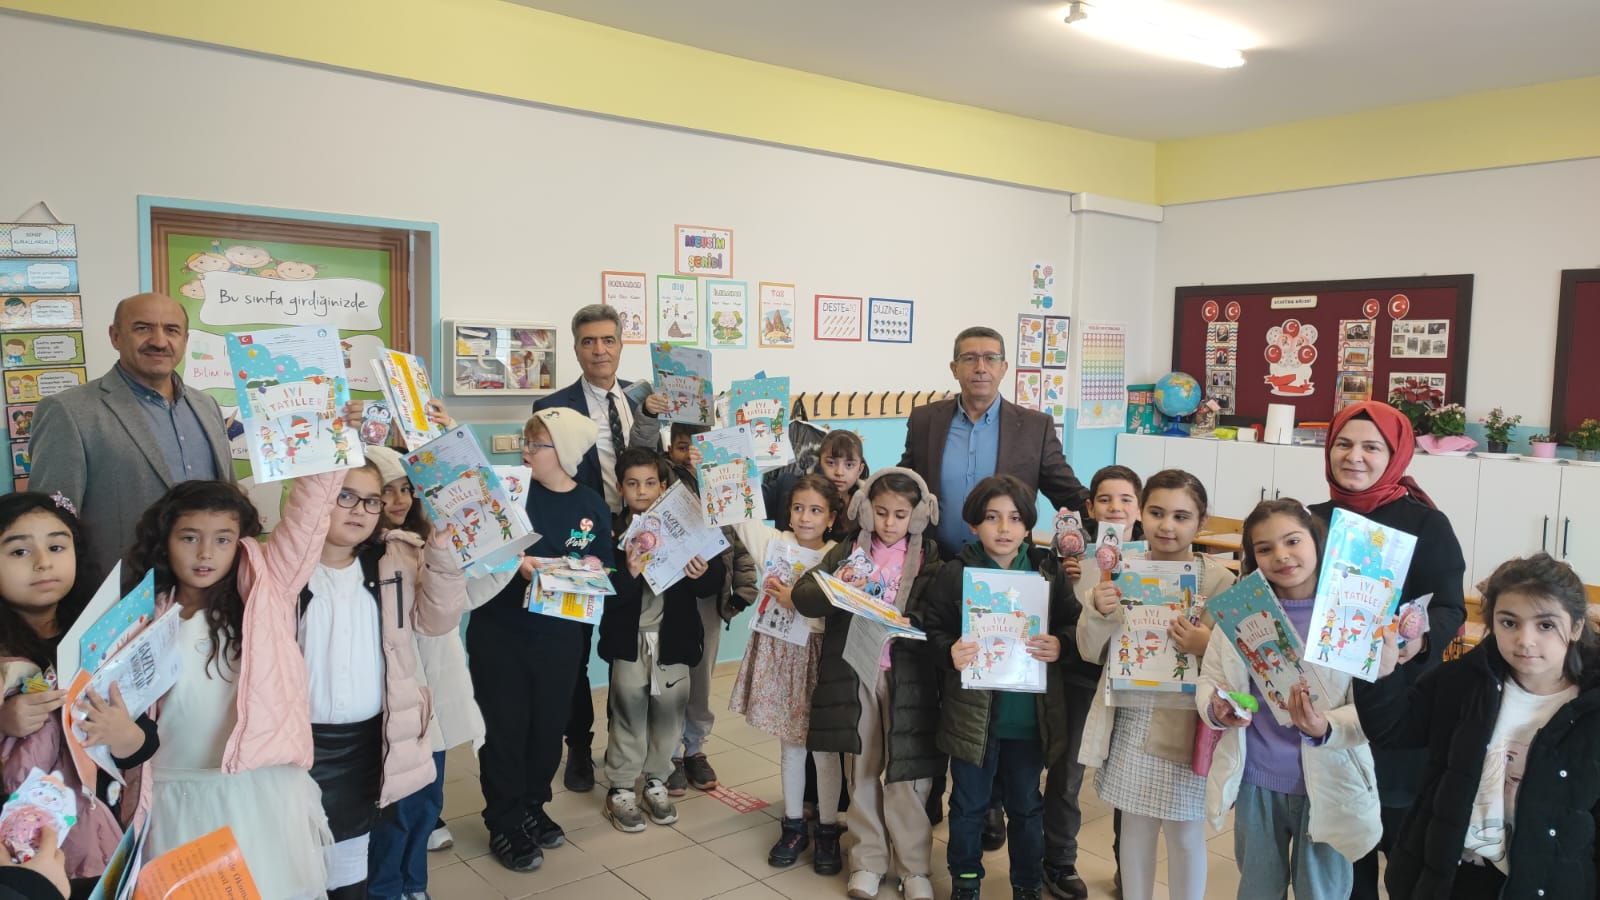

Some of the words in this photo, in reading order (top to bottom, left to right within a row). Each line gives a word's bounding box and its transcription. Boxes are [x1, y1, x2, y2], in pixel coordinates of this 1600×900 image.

[685, 232, 726, 249] MEVSİM
[688, 252, 723, 272] ŞERİDİ
[219, 289, 239, 304] Bu
[244, 290, 283, 305] sınıfa
[283, 290, 369, 316] girdiğinizde
